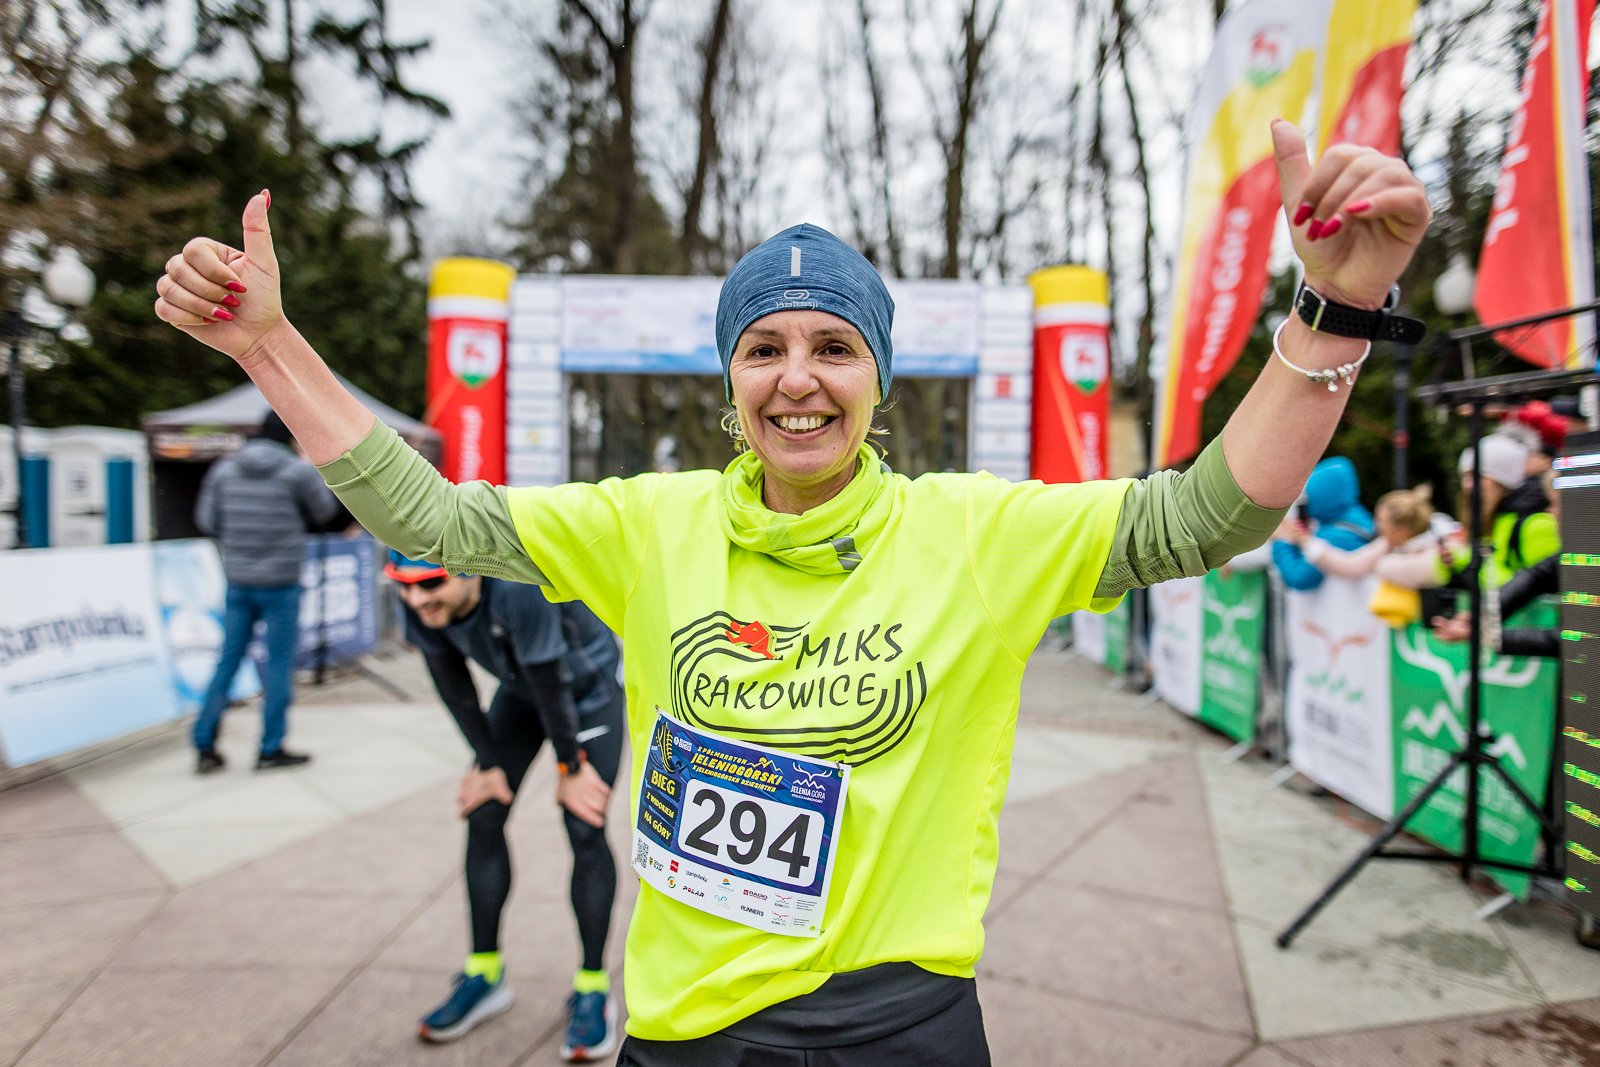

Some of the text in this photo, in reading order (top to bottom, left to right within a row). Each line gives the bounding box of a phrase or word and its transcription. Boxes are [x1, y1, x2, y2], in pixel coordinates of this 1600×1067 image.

[795, 623, 903, 670] MLKS
[693, 672, 876, 710] RAKOWICE
[651, 770, 675, 796] BIEG
[690, 753, 784, 785] JELENIOGÓRSKI
[651, 795, 675, 818] WIDOKIEM
[644, 811, 671, 840] NA GÓRY
[685, 788, 810, 879] 294
